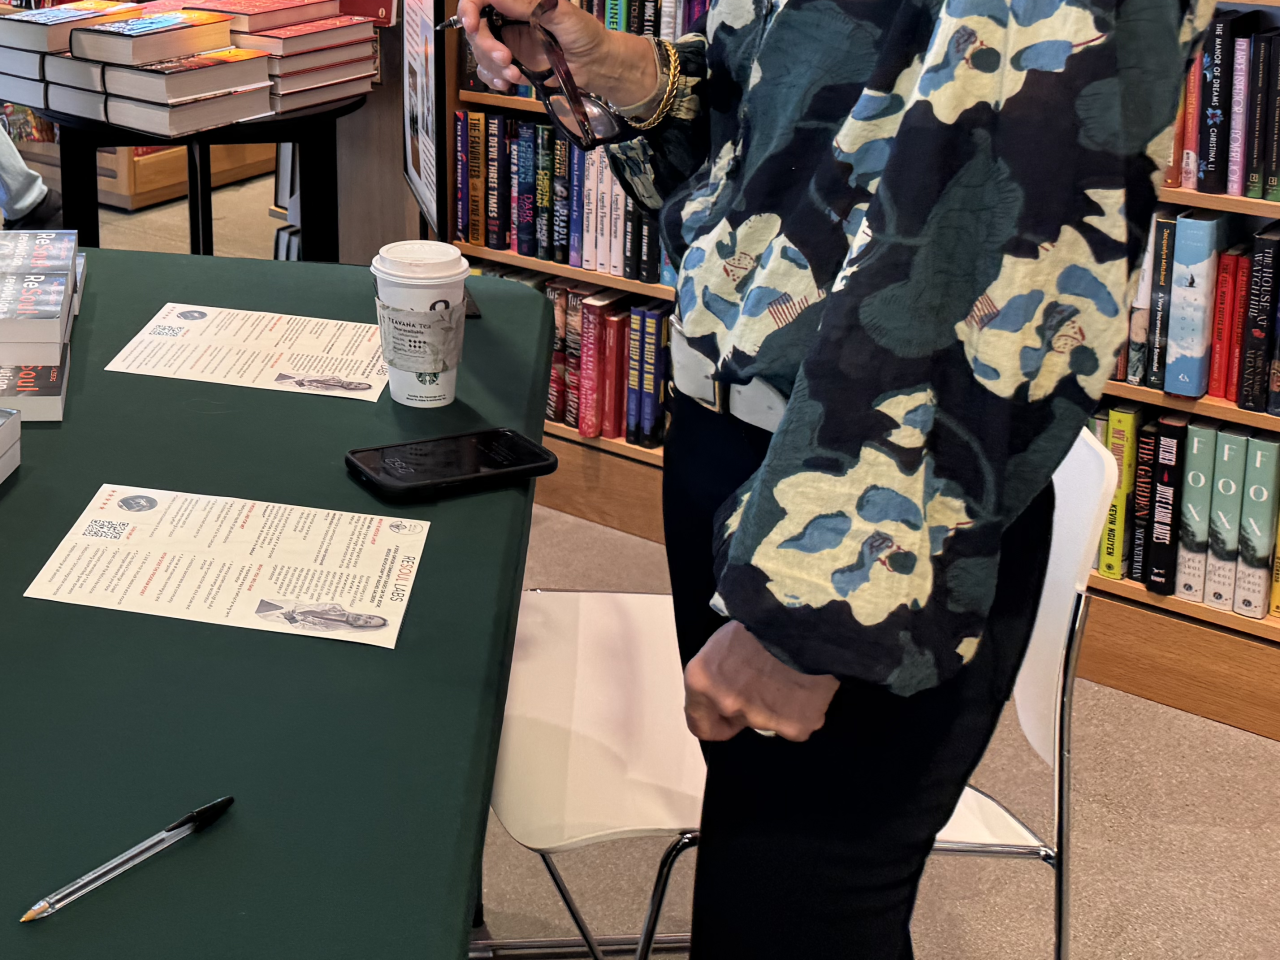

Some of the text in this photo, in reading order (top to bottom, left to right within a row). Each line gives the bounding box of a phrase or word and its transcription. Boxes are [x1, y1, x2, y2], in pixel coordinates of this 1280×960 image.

[1211, 24, 1224, 106] THE MANOR OF DREAMS
[488, 119, 498, 218] THE DEVIL THREE TIMES
[524, 142, 533, 183] CHRISTINE
[523, 194, 534, 223] DARK
[559, 209, 568, 246] DEADLY
[12, 233, 30, 267] revolution
[31, 233, 56, 268] ReSoul
[17, 275, 46, 315] ReSoul
[568, 294, 583, 308] THE
[387, 316, 416, 328] TEAVANA
[1243, 349, 1256, 396] MONING
[1158, 437, 1178, 466] BUTCHER
[1134, 437, 1155, 518] THE GARDEN
[1187, 437, 1207, 522] FOX
[1217, 444, 1237, 530] FOX
[1248, 450, 1270, 537] FOX
[1106, 504, 1118, 557] KEVIN NGUYEN
[389, 554, 417, 604] RESOUL LABS
